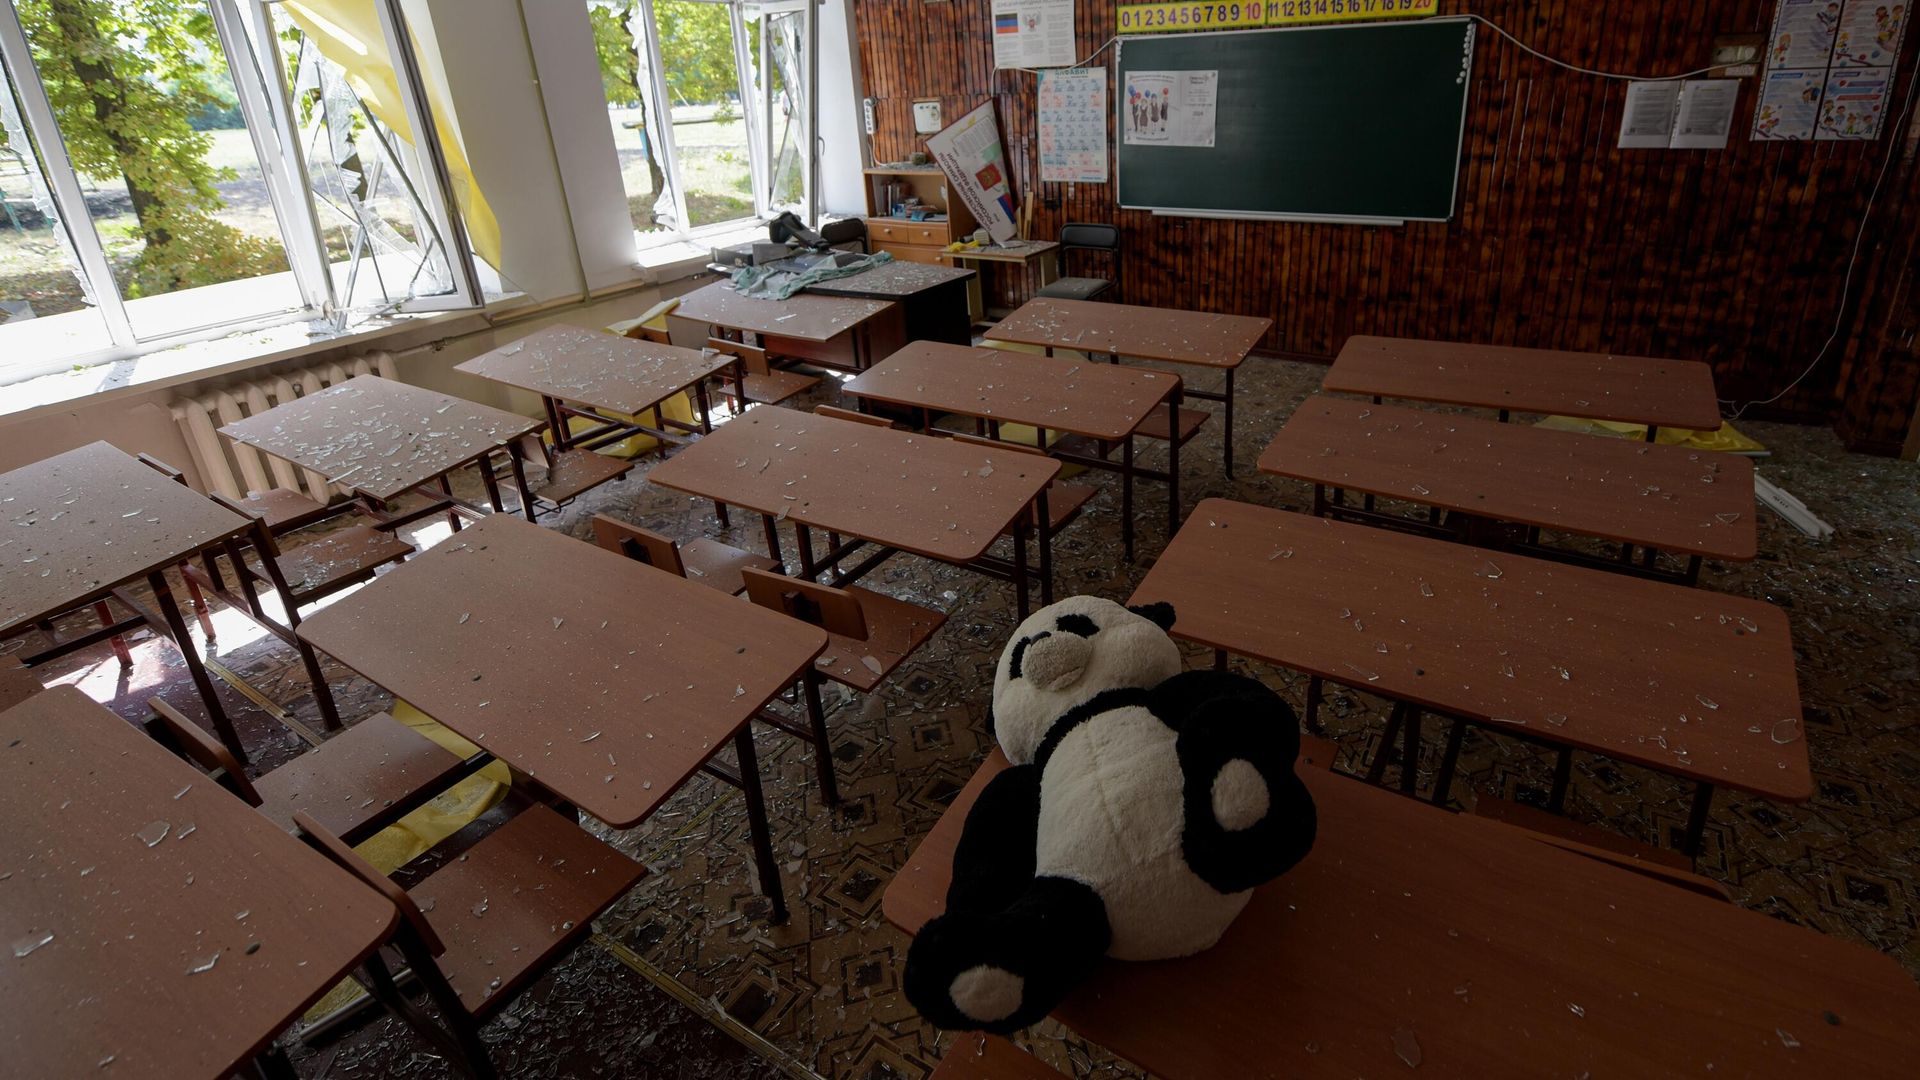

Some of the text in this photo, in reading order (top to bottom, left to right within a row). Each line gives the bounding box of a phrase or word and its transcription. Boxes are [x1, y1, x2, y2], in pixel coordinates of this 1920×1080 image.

[1122, 2, 1261, 27] 0 1 2 3 4 5 6 7 8 9 10
[1268, 3, 1279, 17] 11
[1282, 2, 1295, 17] 12
[1298, 0, 1311, 16] 13
[1314, 0, 1327, 15] 14
[1331, 0, 1344, 14] 15
[1347, 0, 1360, 13] 16
[1364, 0, 1376, 12] 17
[1382, 0, 1394, 10] 18
[937, 151, 960, 183] СИМВОЛЫ
[945, 151, 970, 187] ФЕДЕРАЦИИ
[965, 184, 994, 225] РОССИЙСКОЙ
